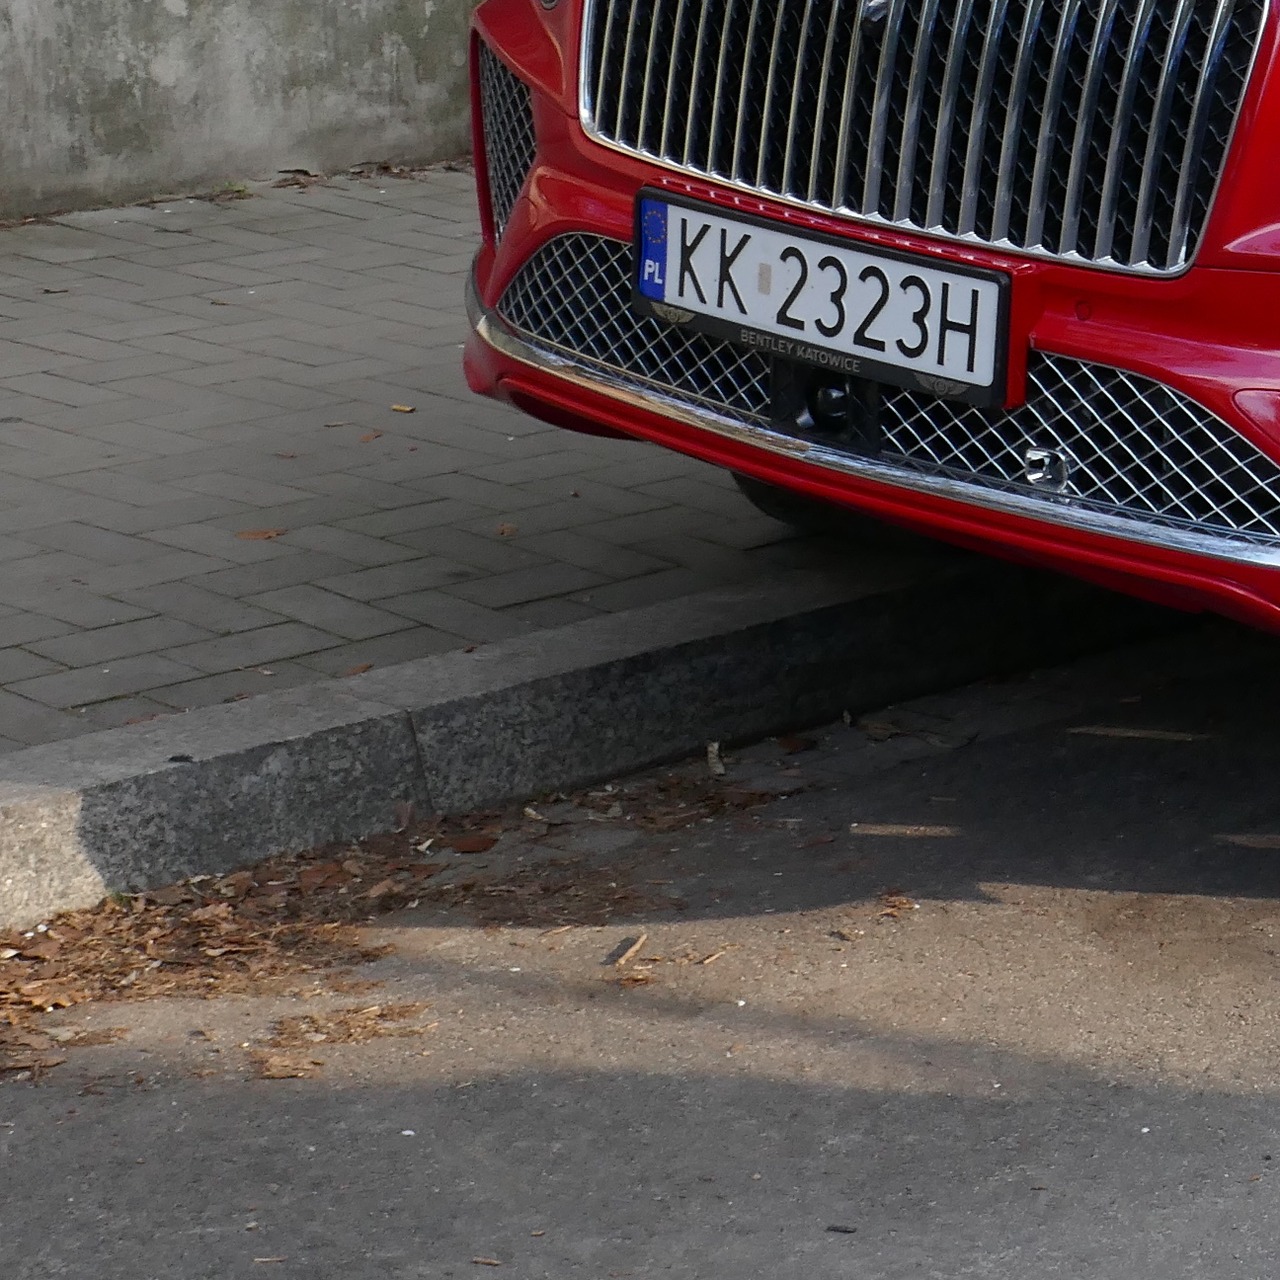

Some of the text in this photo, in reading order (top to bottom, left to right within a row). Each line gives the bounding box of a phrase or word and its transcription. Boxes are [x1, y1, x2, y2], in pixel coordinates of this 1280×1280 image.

[643, 259, 664, 285] PL
[678, 217, 980, 373] KK 2323H
[740, 329, 861, 373] BENTLEY KATOWICE
